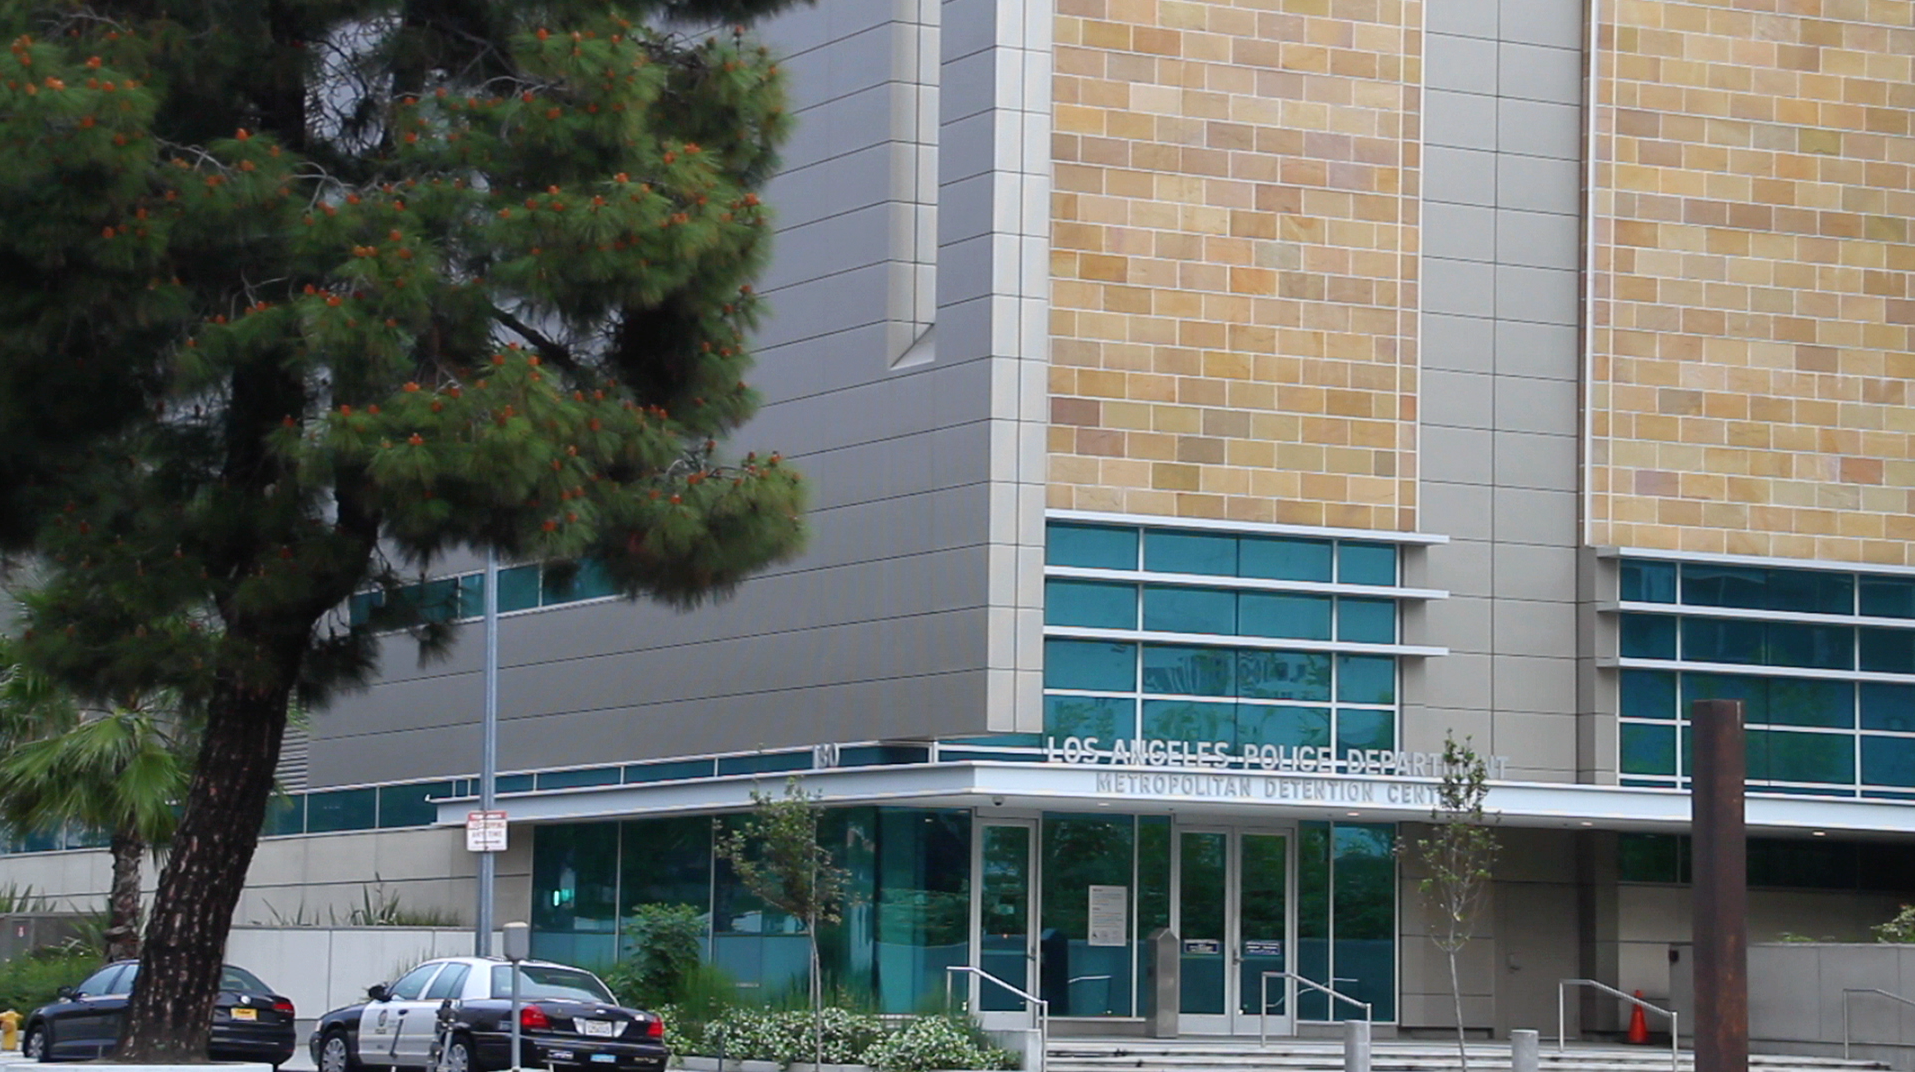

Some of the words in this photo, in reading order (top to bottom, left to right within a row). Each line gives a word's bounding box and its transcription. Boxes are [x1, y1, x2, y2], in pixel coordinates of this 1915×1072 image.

[1048, 736, 1099, 764] LOS
[1110, 738, 1229, 769] ANGELES
[1243, 743, 1331, 772] POLICE
[1096, 773, 1250, 797] METROPOLITAN
[1264, 778, 1374, 801] DETENTION
